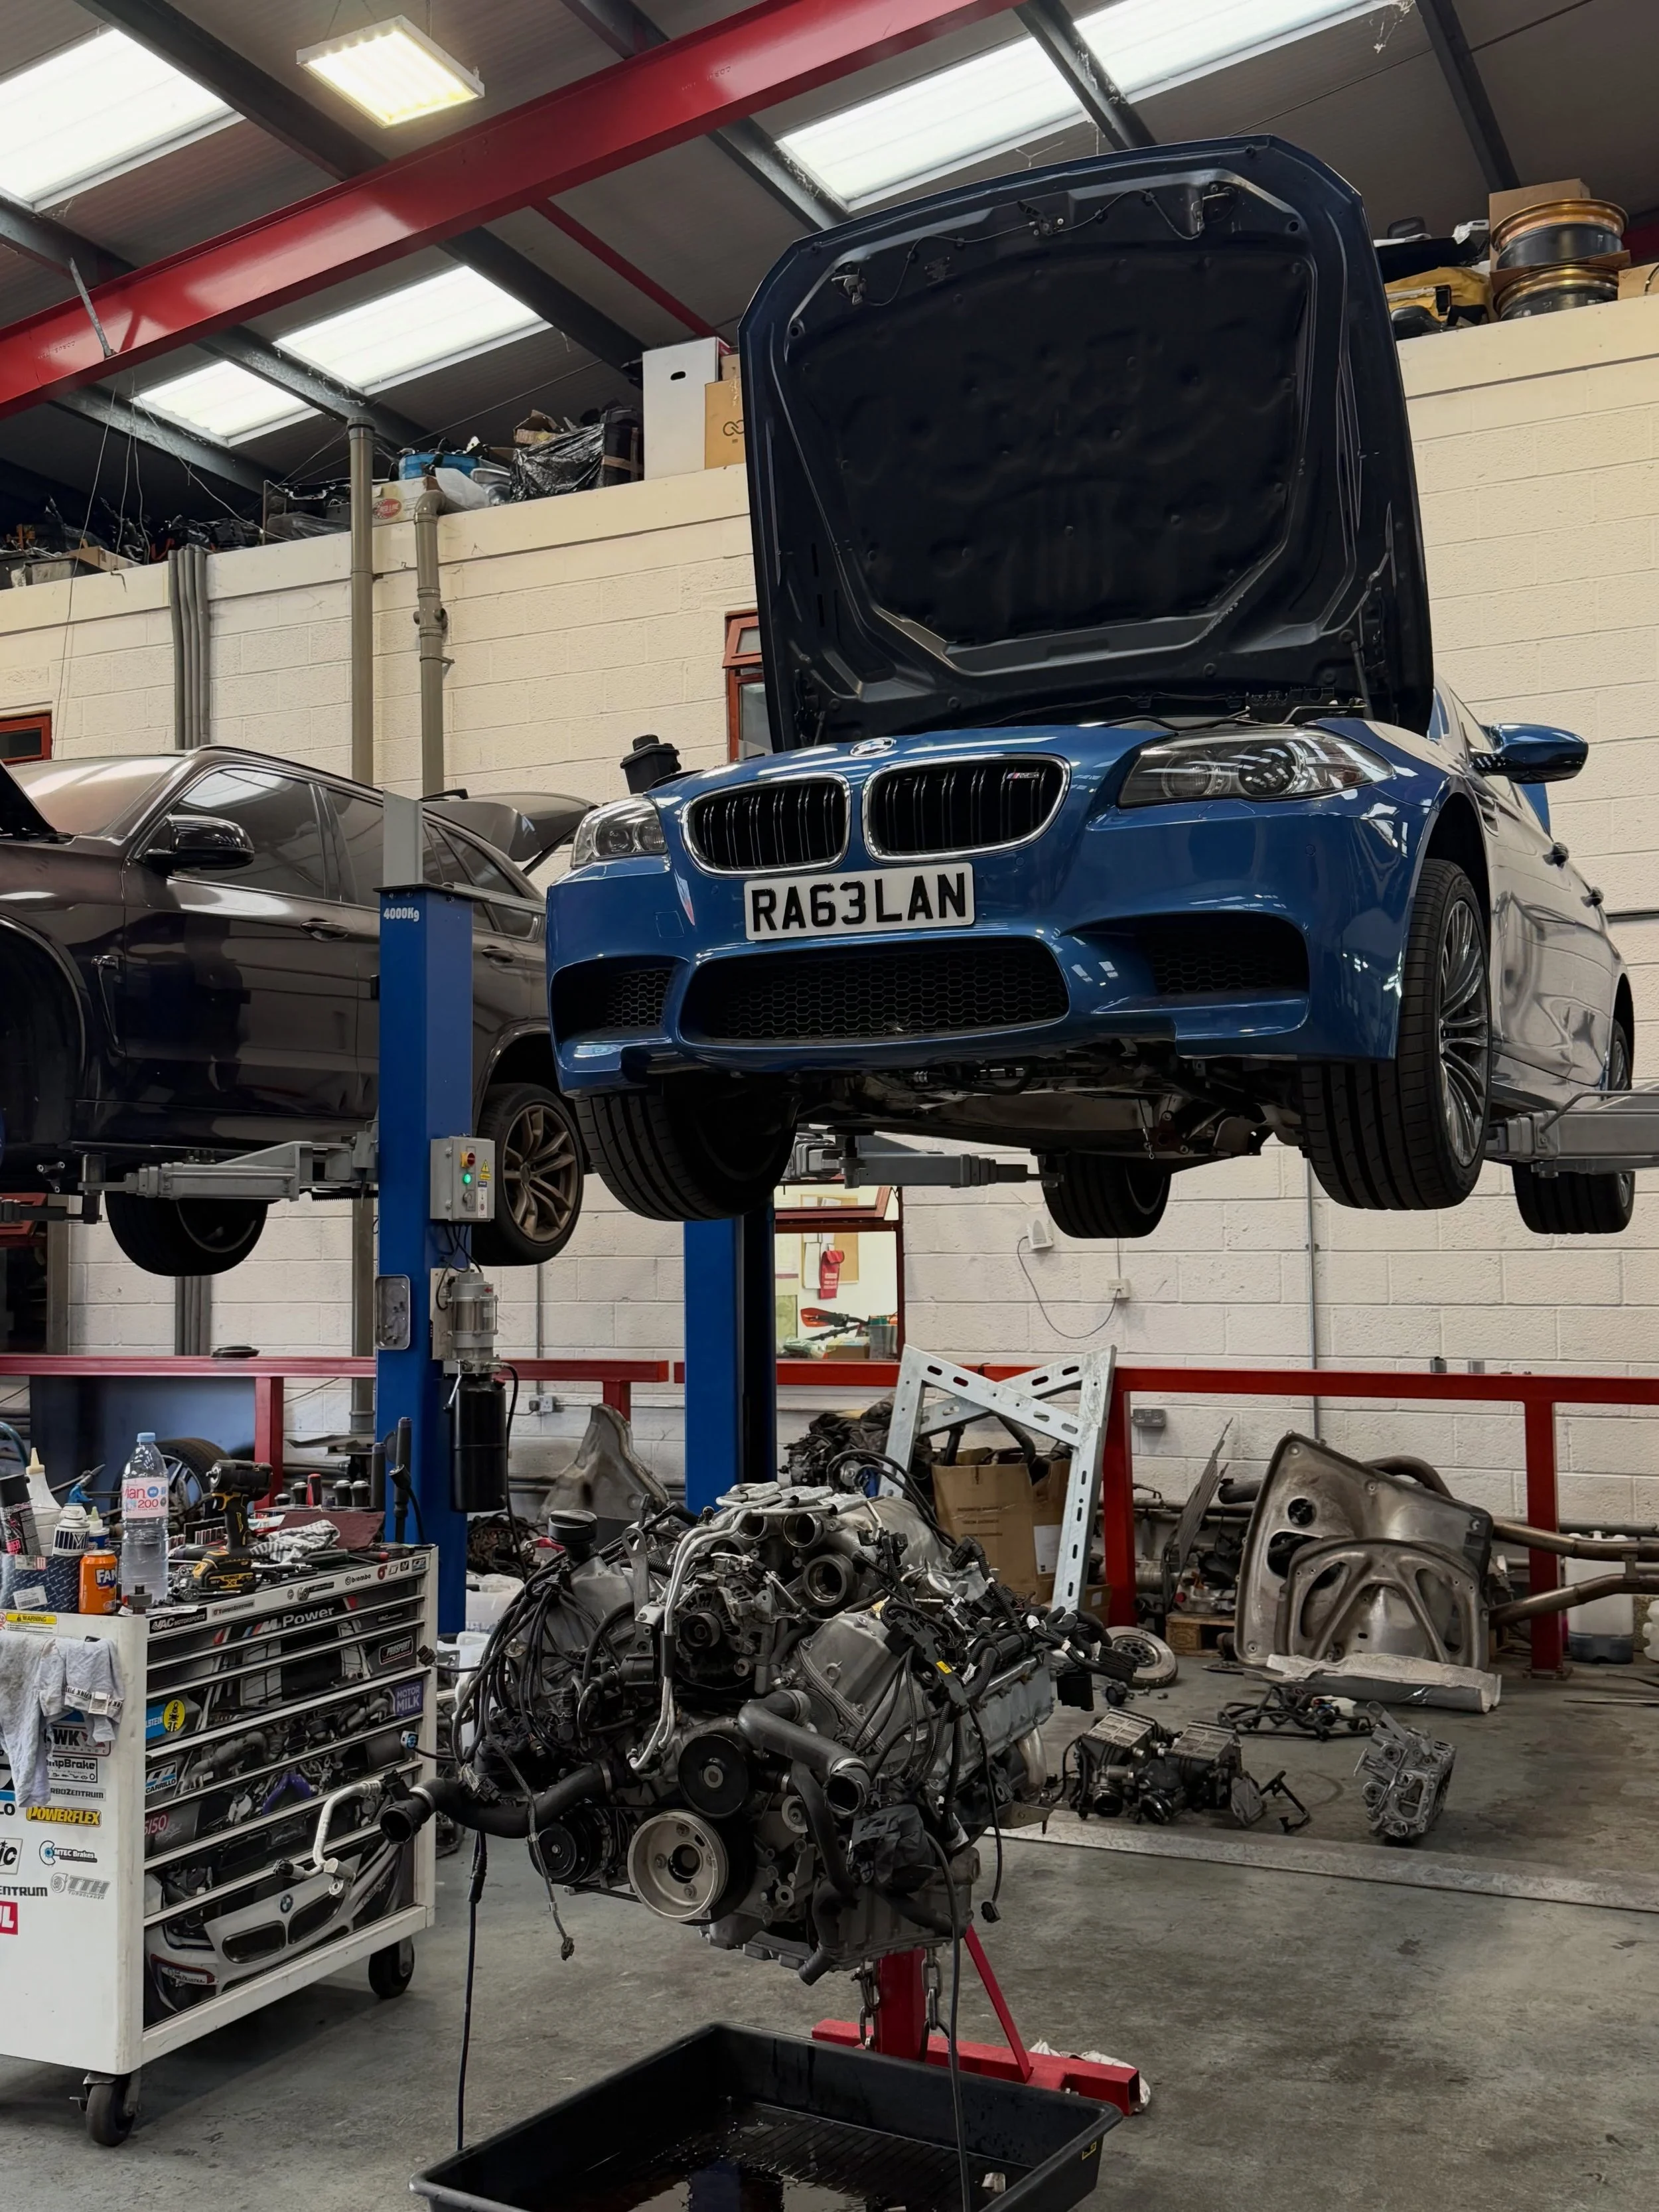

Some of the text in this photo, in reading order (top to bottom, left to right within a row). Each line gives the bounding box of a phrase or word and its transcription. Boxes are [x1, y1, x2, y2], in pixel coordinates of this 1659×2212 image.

[384, 907, 419, 922] 4000Kg
[137, 1499, 159, 1508] 200
[352, 1574, 371, 1583] brembo
[283, 1607, 334, 1627] Power
[397, 1686, 420, 1698] MOTOR
[397, 1694, 420, 1712] MILK
[146, 1779, 176, 1793] CARRILLO
[27, 1806, 100, 1825] POWERFLEX
[68, 1875, 111, 1895] TTH
